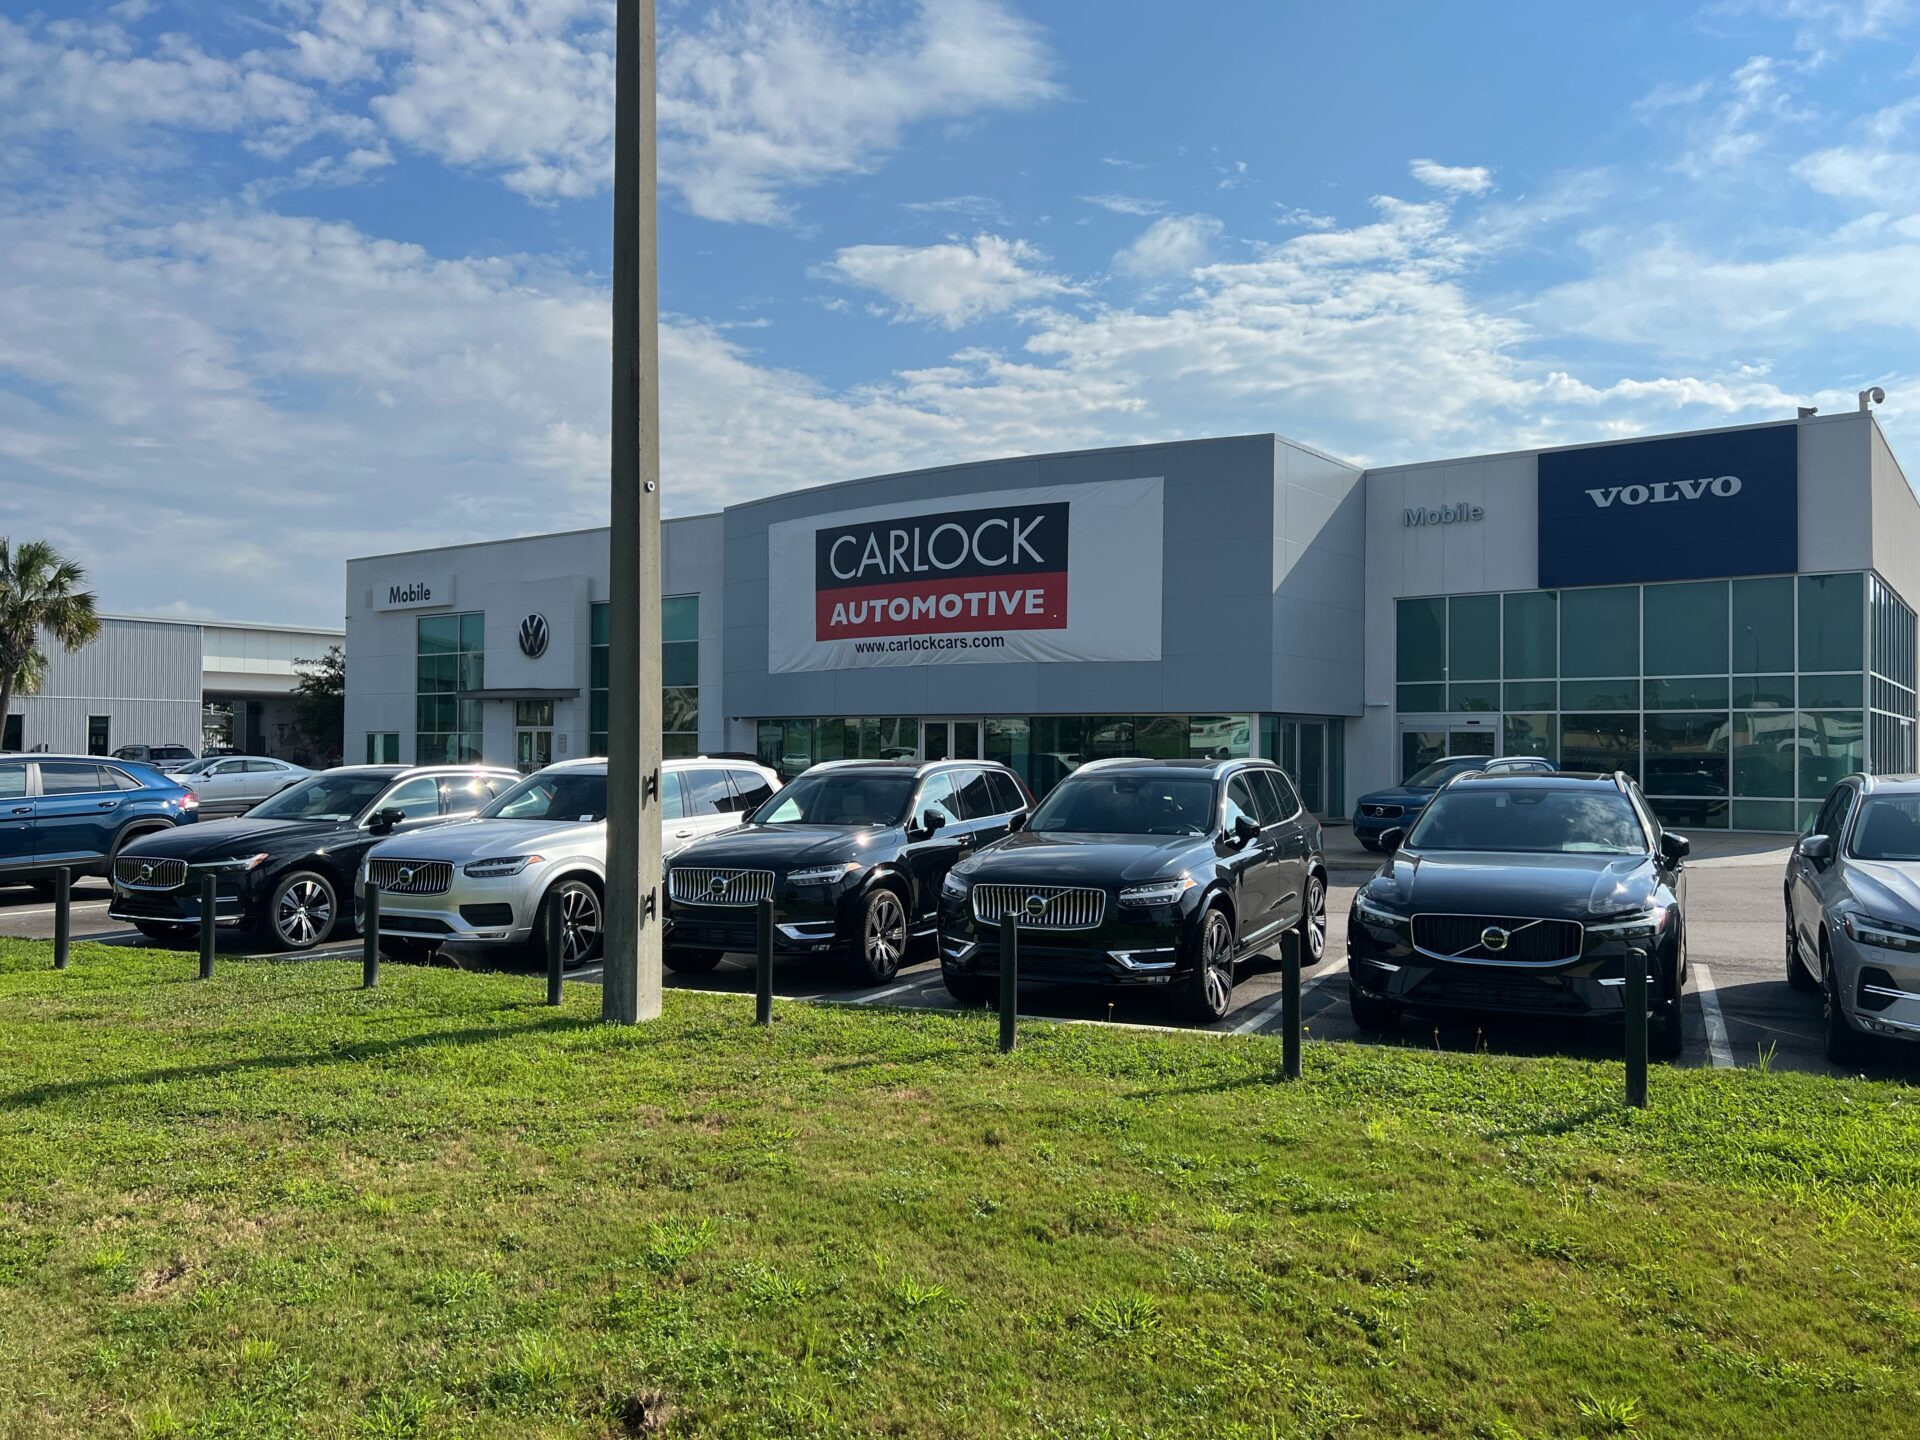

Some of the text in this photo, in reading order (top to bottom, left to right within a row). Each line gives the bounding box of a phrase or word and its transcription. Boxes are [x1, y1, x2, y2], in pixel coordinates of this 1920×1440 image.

[1585, 475, 1742, 508] VOLVO
[1403, 503, 1485, 527] Mobile
[829, 515, 1045, 579] CARLOCK
[389, 582, 431, 604] Mobile
[830, 588, 1044, 626] AUTOMOTIVE
[855, 634, 1005, 653] www.carlockcars.com
[294, 657, 329, 665] Servic
